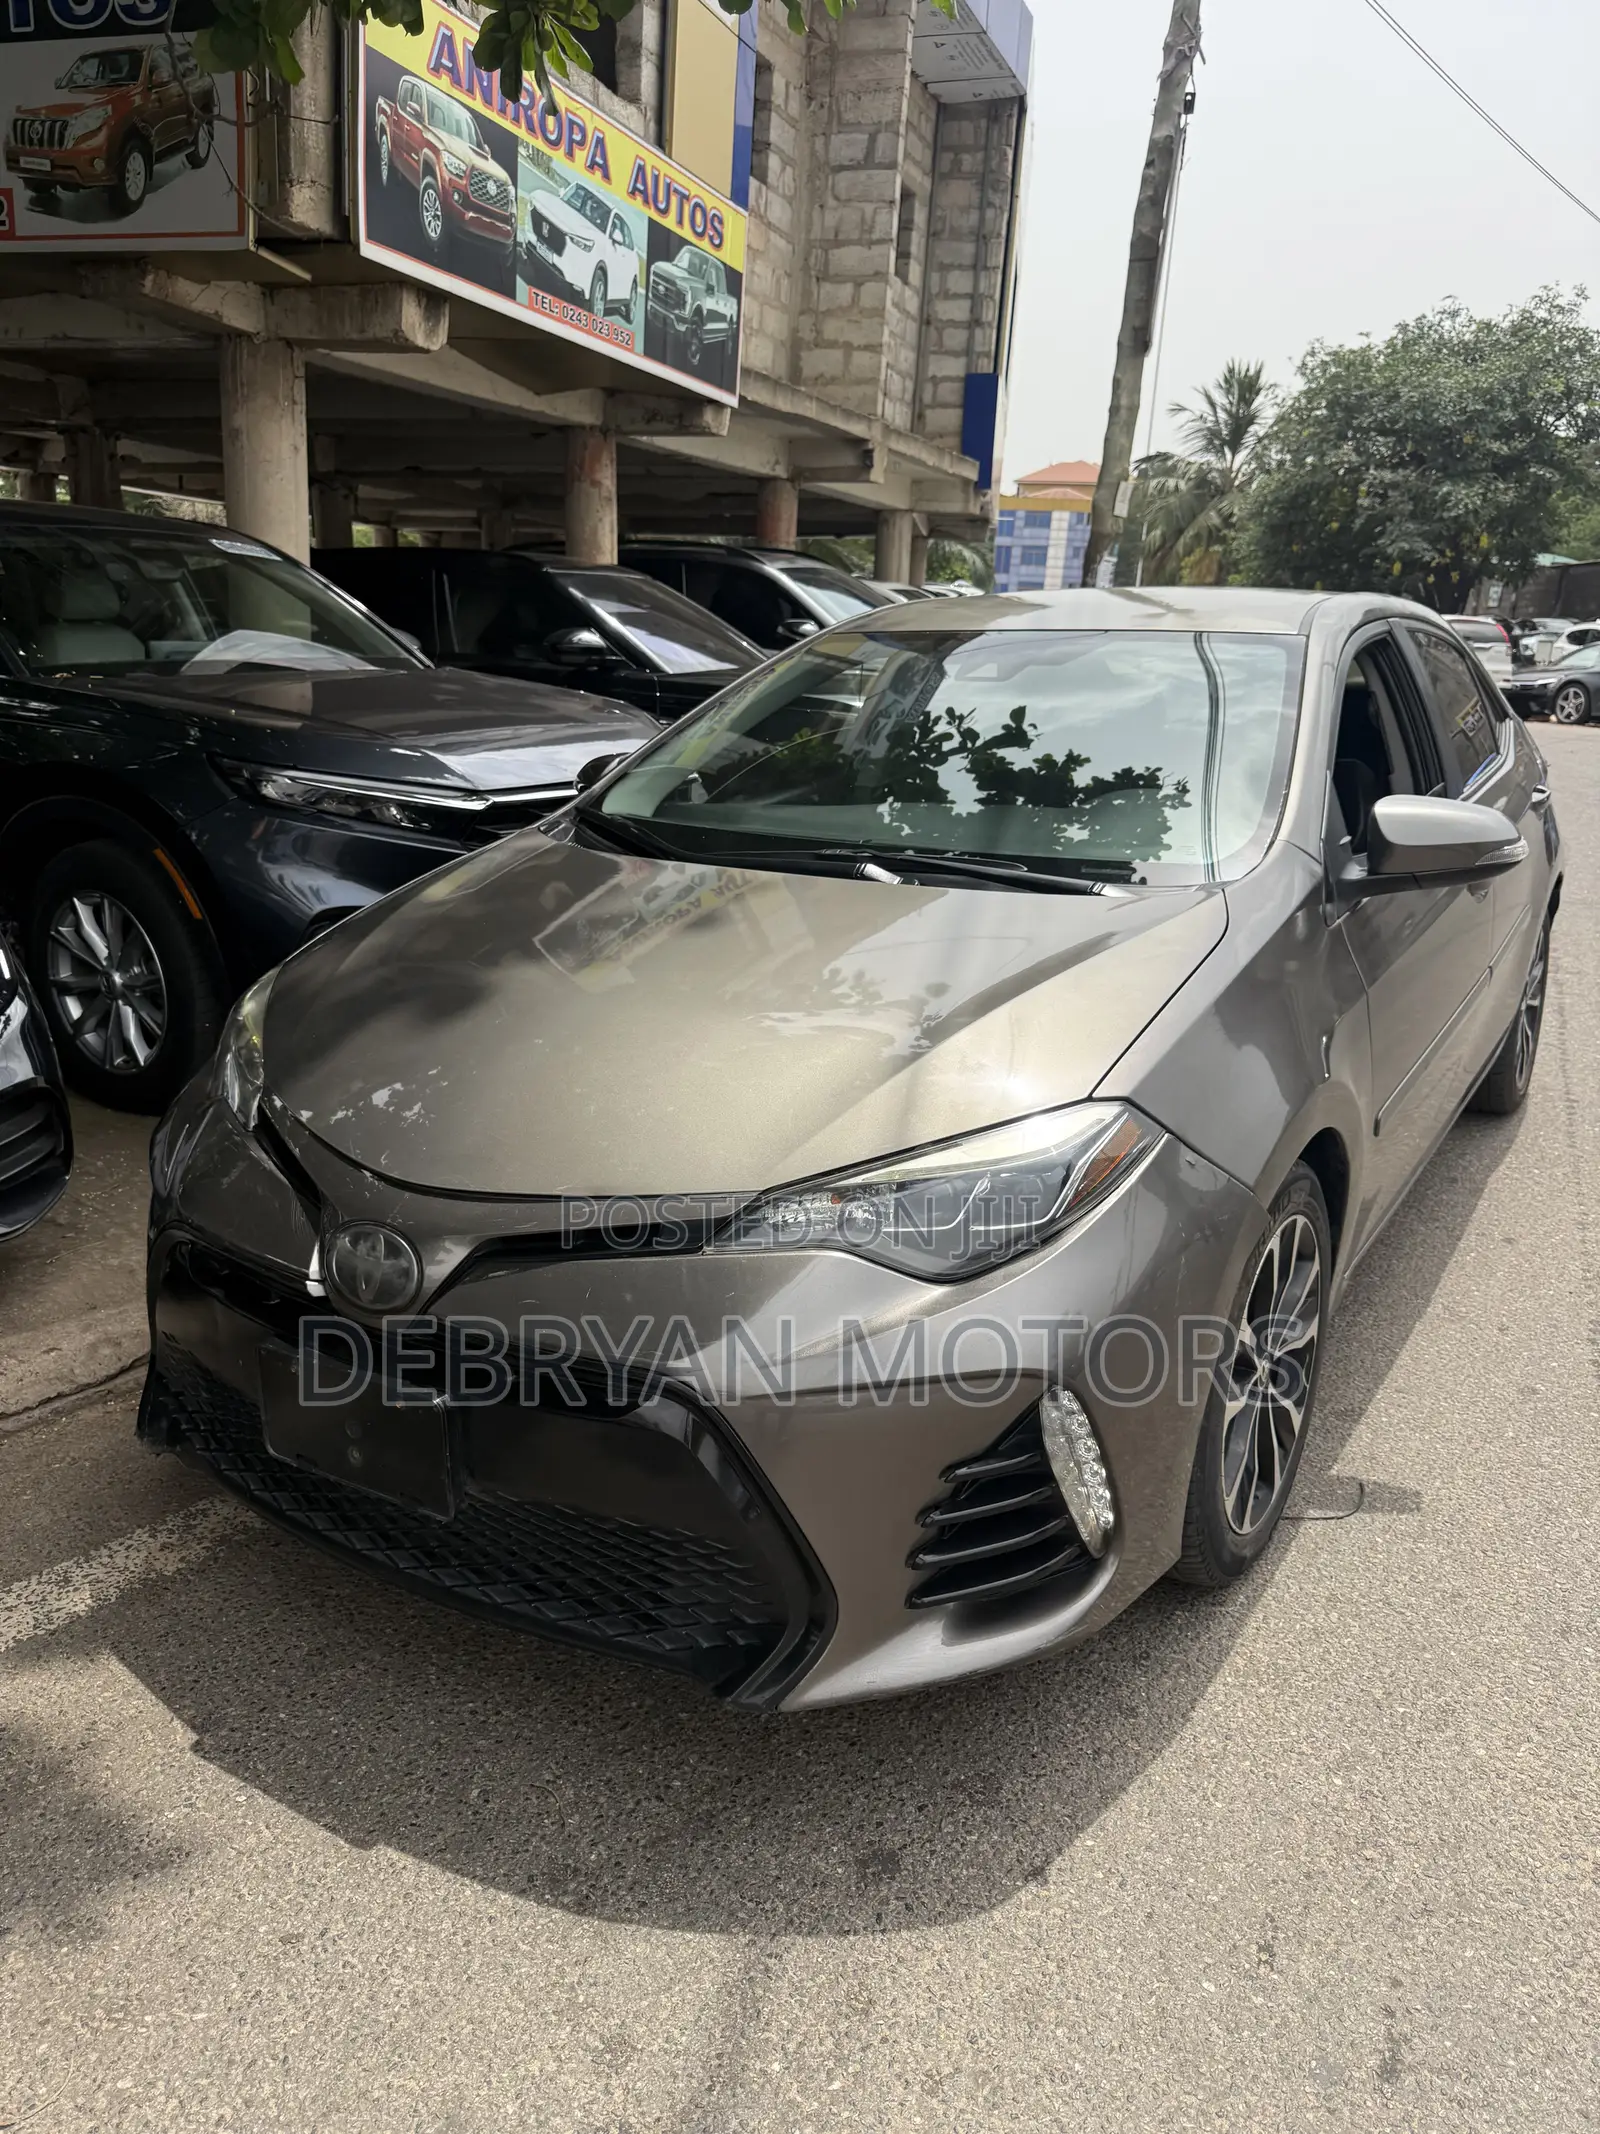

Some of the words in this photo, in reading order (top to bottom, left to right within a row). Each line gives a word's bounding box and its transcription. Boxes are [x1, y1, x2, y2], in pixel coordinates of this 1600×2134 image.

[627, 155, 724, 251] AUTOS
[532, 290, 559, 315] TEL:
[561, 304, 589, 329] 0243
[591, 317, 611, 338] 023
[612, 327, 632, 347] 952
